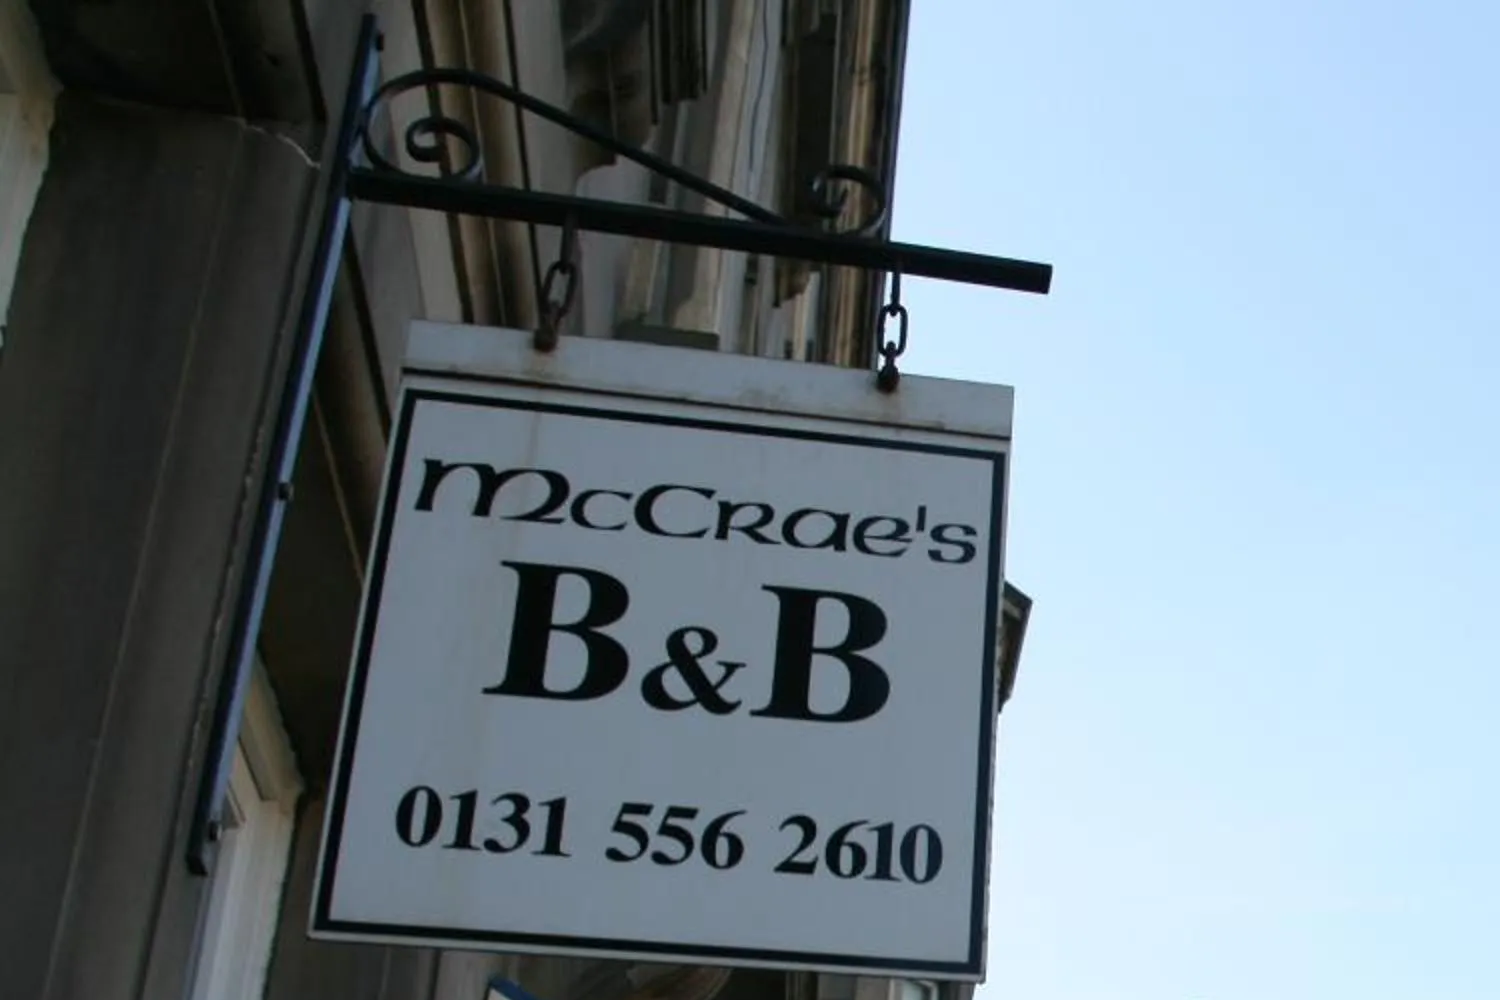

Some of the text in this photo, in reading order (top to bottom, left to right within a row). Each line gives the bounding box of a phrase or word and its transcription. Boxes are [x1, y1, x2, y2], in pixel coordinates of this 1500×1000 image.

[481, 559, 891, 723] B&B
[395, 785, 944, 884] 0131 556 2610
